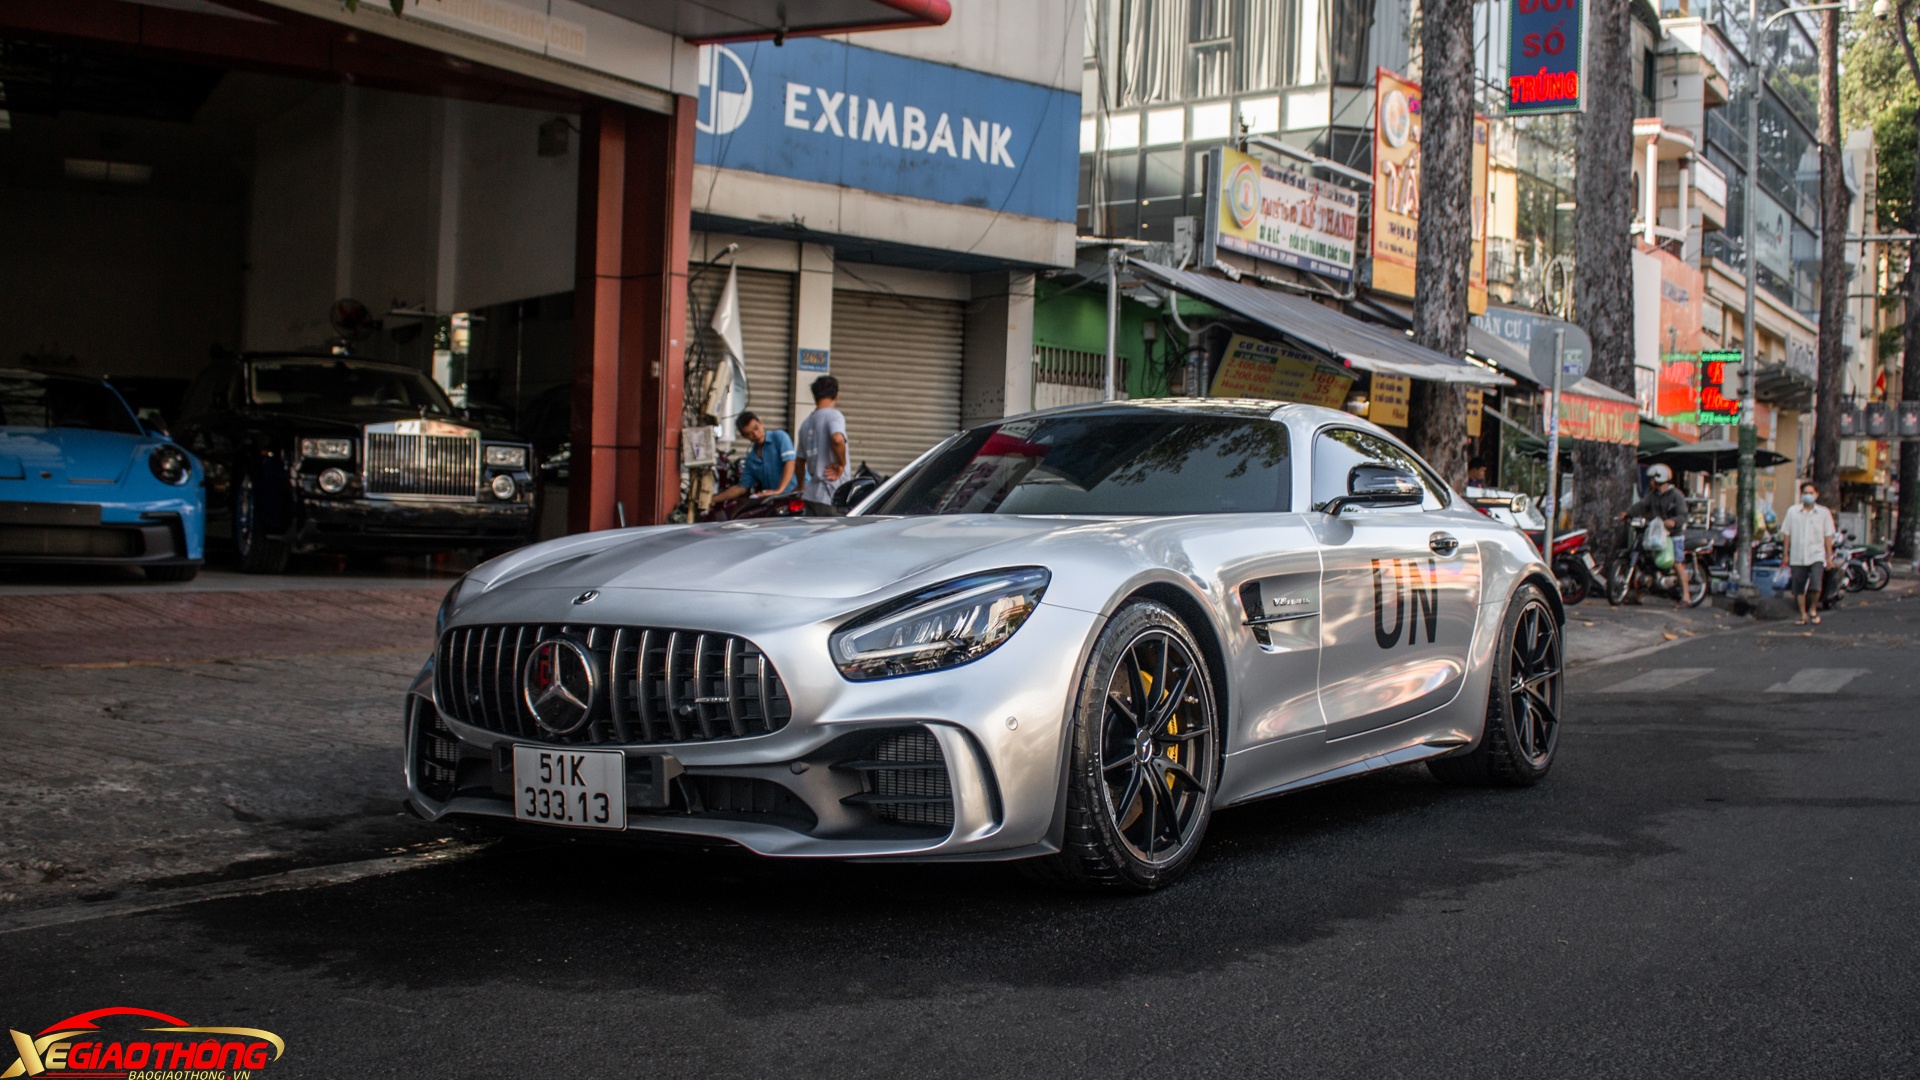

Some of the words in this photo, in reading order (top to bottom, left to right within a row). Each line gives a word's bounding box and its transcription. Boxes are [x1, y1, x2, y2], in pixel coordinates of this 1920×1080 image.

[1522, 19, 1566, 58] SỐ
[1509, 66, 1579, 103] TRÚNG
[785, 82, 1015, 168] EXIMBANK
[1318, 204, 1356, 241] THANH
[1475, 313, 1502, 334] DÂN
[1504, 318, 1523, 338] CƯ
[1525, 323, 1531, 340] 1
[1310, 372, 1336, 385] 160
[1371, 558, 1438, 649] UN
[540, 753, 587, 786] 51K
[525, 787, 610, 823] 333.13
